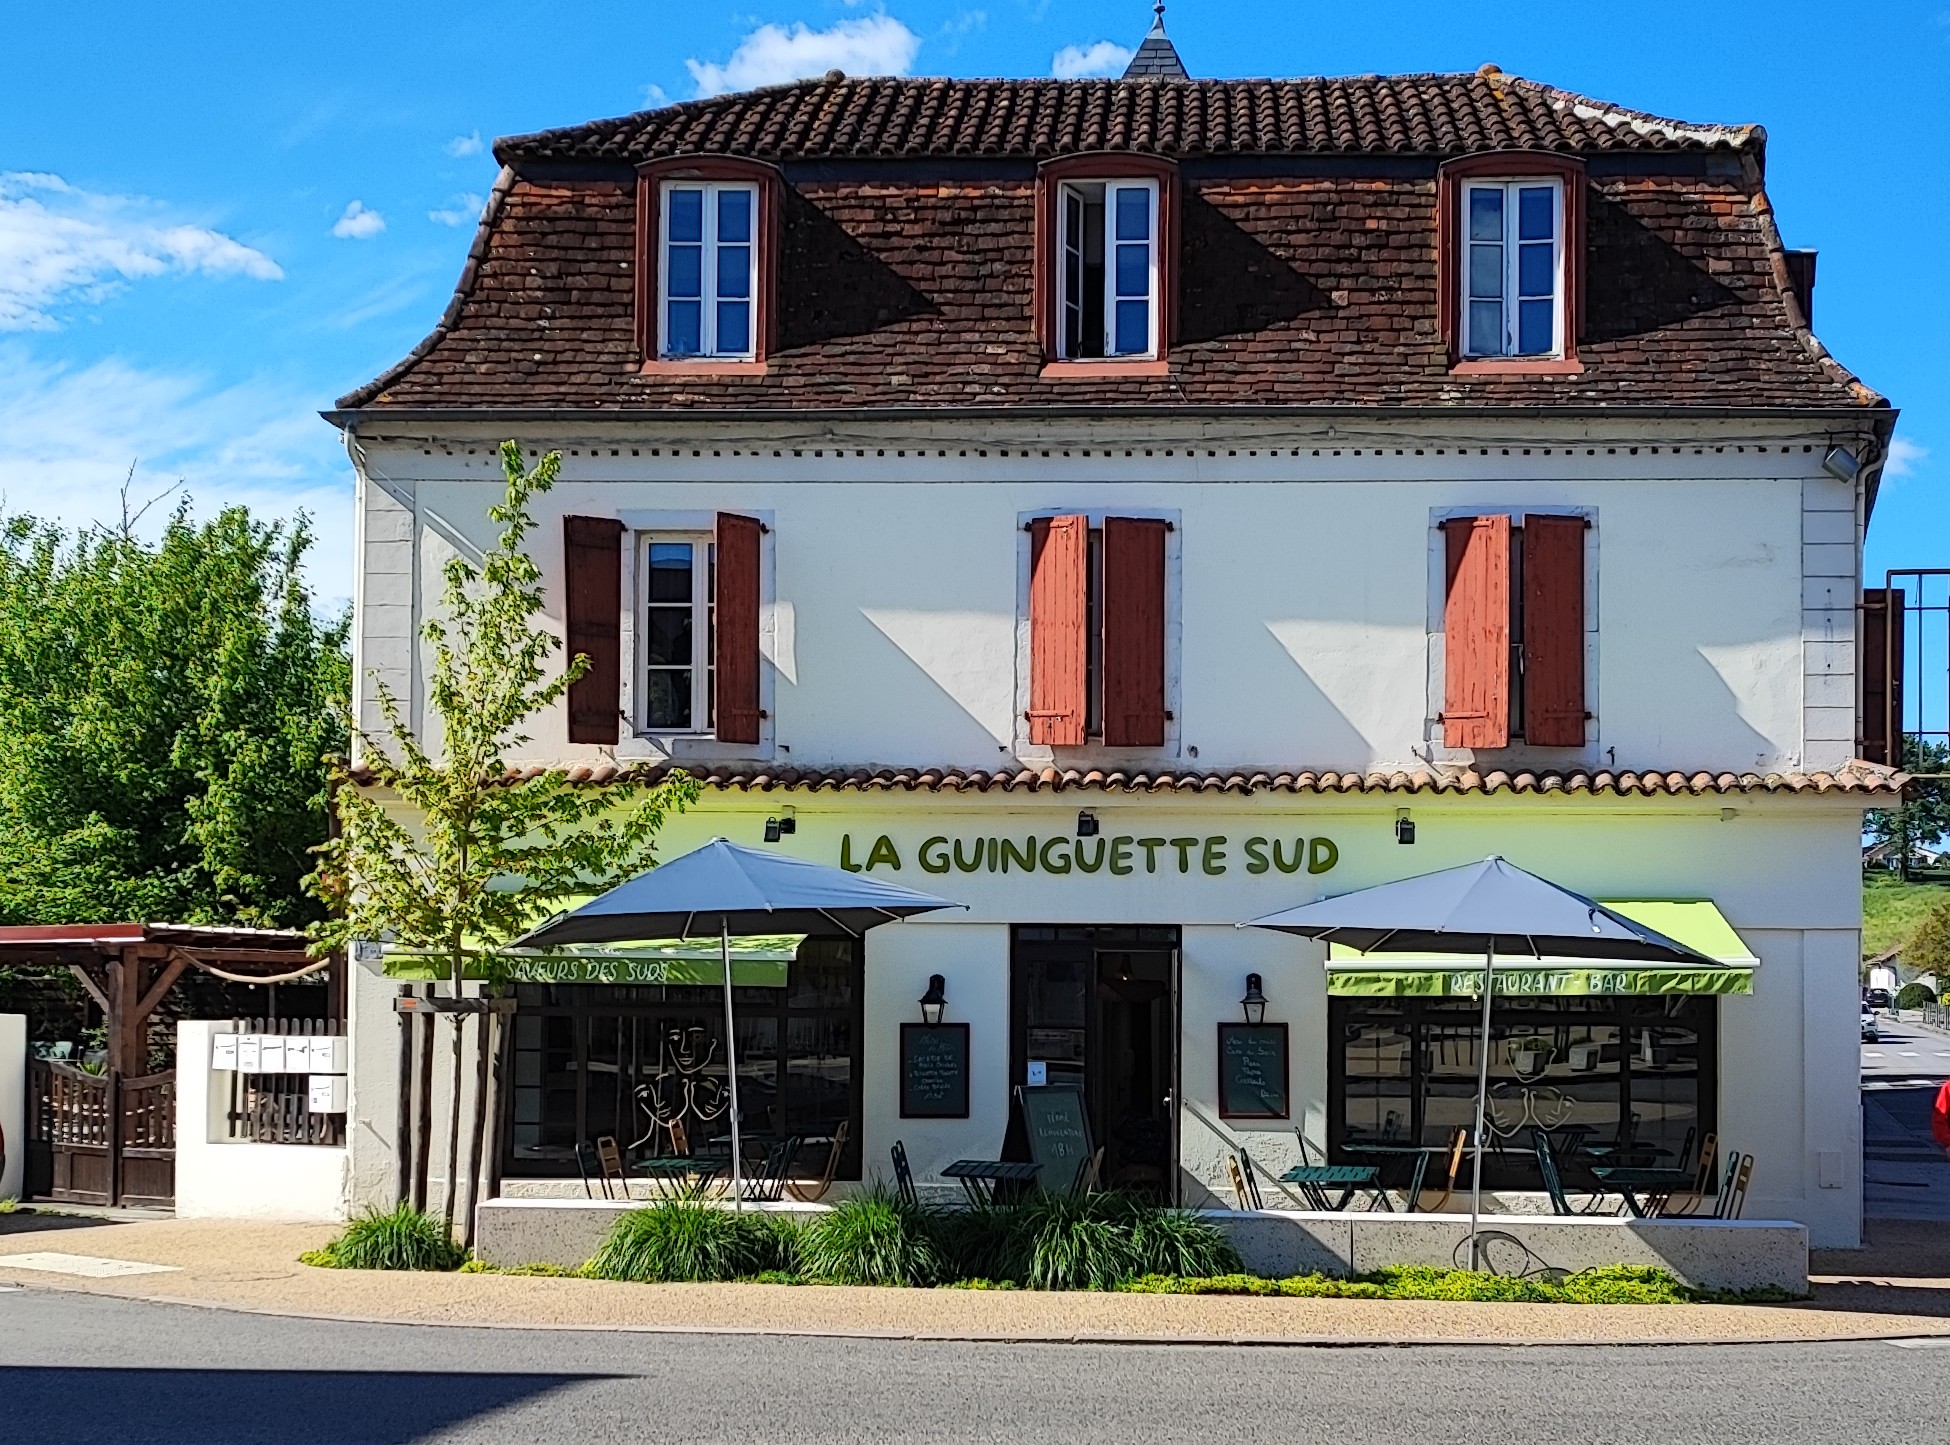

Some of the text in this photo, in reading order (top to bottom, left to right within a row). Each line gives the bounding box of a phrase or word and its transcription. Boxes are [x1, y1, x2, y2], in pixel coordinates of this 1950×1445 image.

[841, 834, 1339, 875] LA GUINGUETTE SUD
[505, 960, 669, 982] SAVEURS DES SUDS
[1590, 973, 1628, 993] BAR
[1051, 1141, 1075, 1159] 18H
